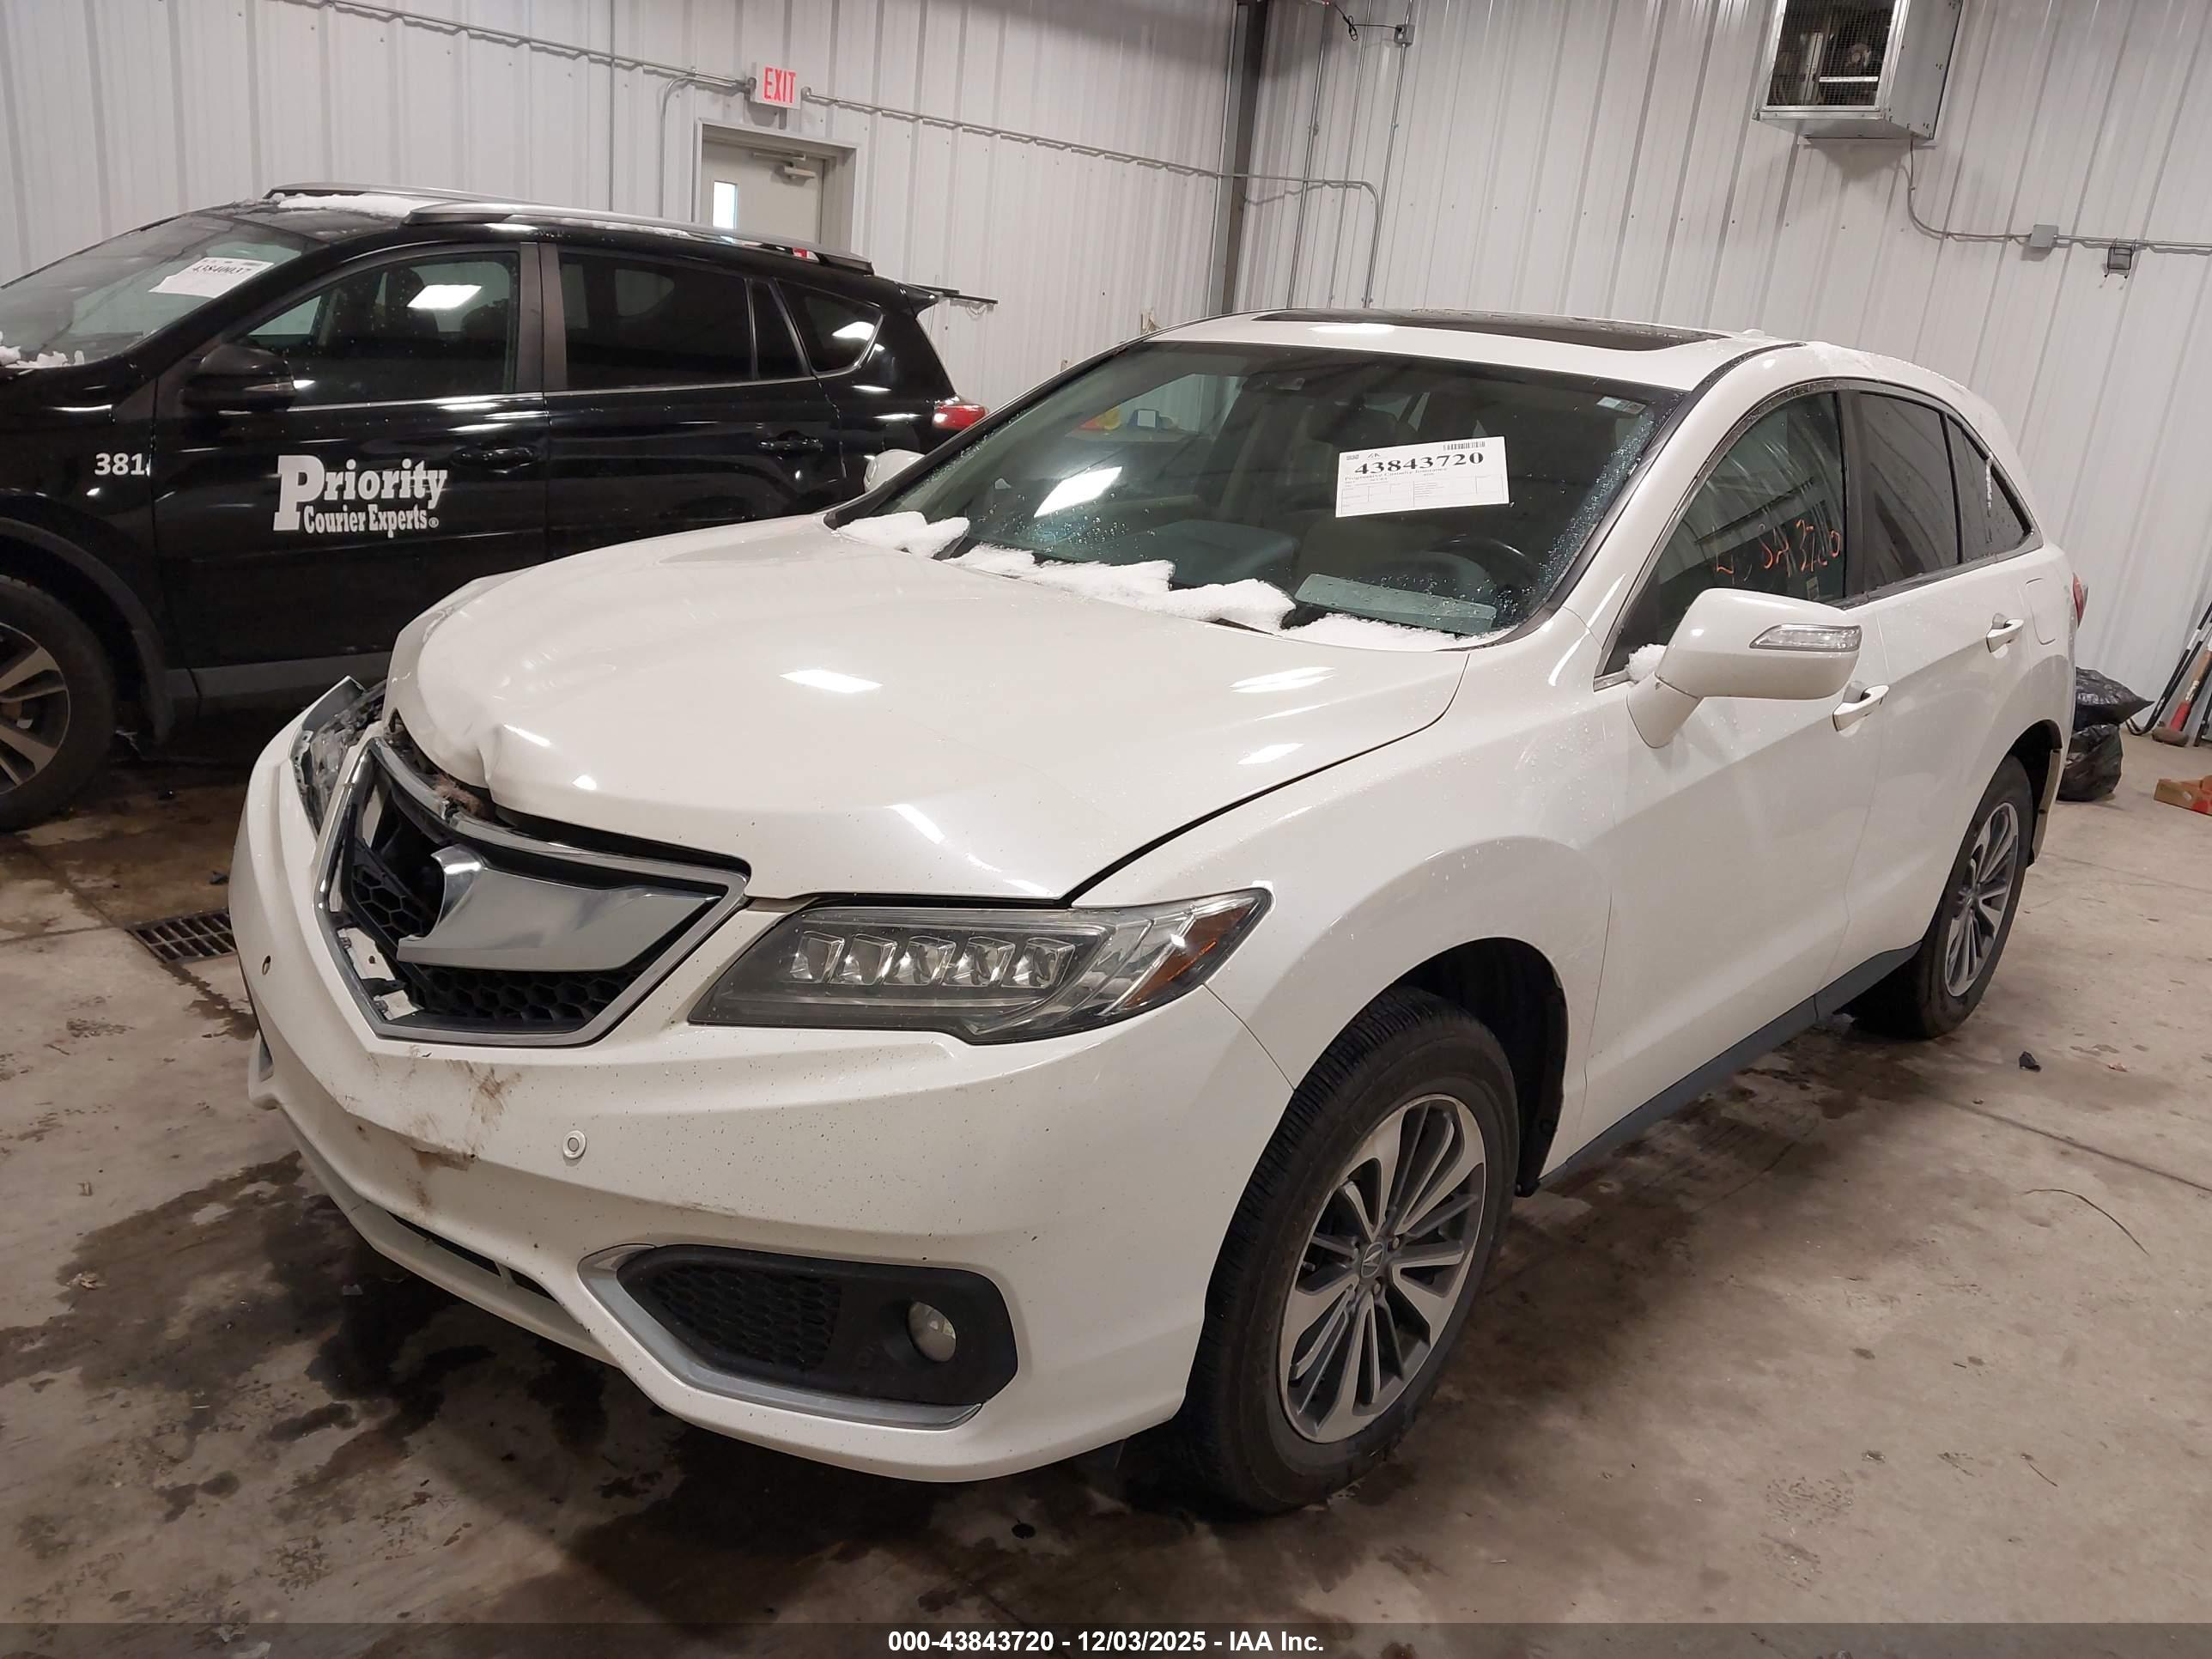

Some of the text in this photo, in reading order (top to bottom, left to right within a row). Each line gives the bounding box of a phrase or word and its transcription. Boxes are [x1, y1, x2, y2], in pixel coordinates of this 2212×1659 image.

[763, 67, 797, 104] EXIT
[94, 453, 145, 476] 381
[1354, 452, 1485, 475] 43843720
[273, 454, 448, 532] Priority
[303, 504, 366, 534] Courier
